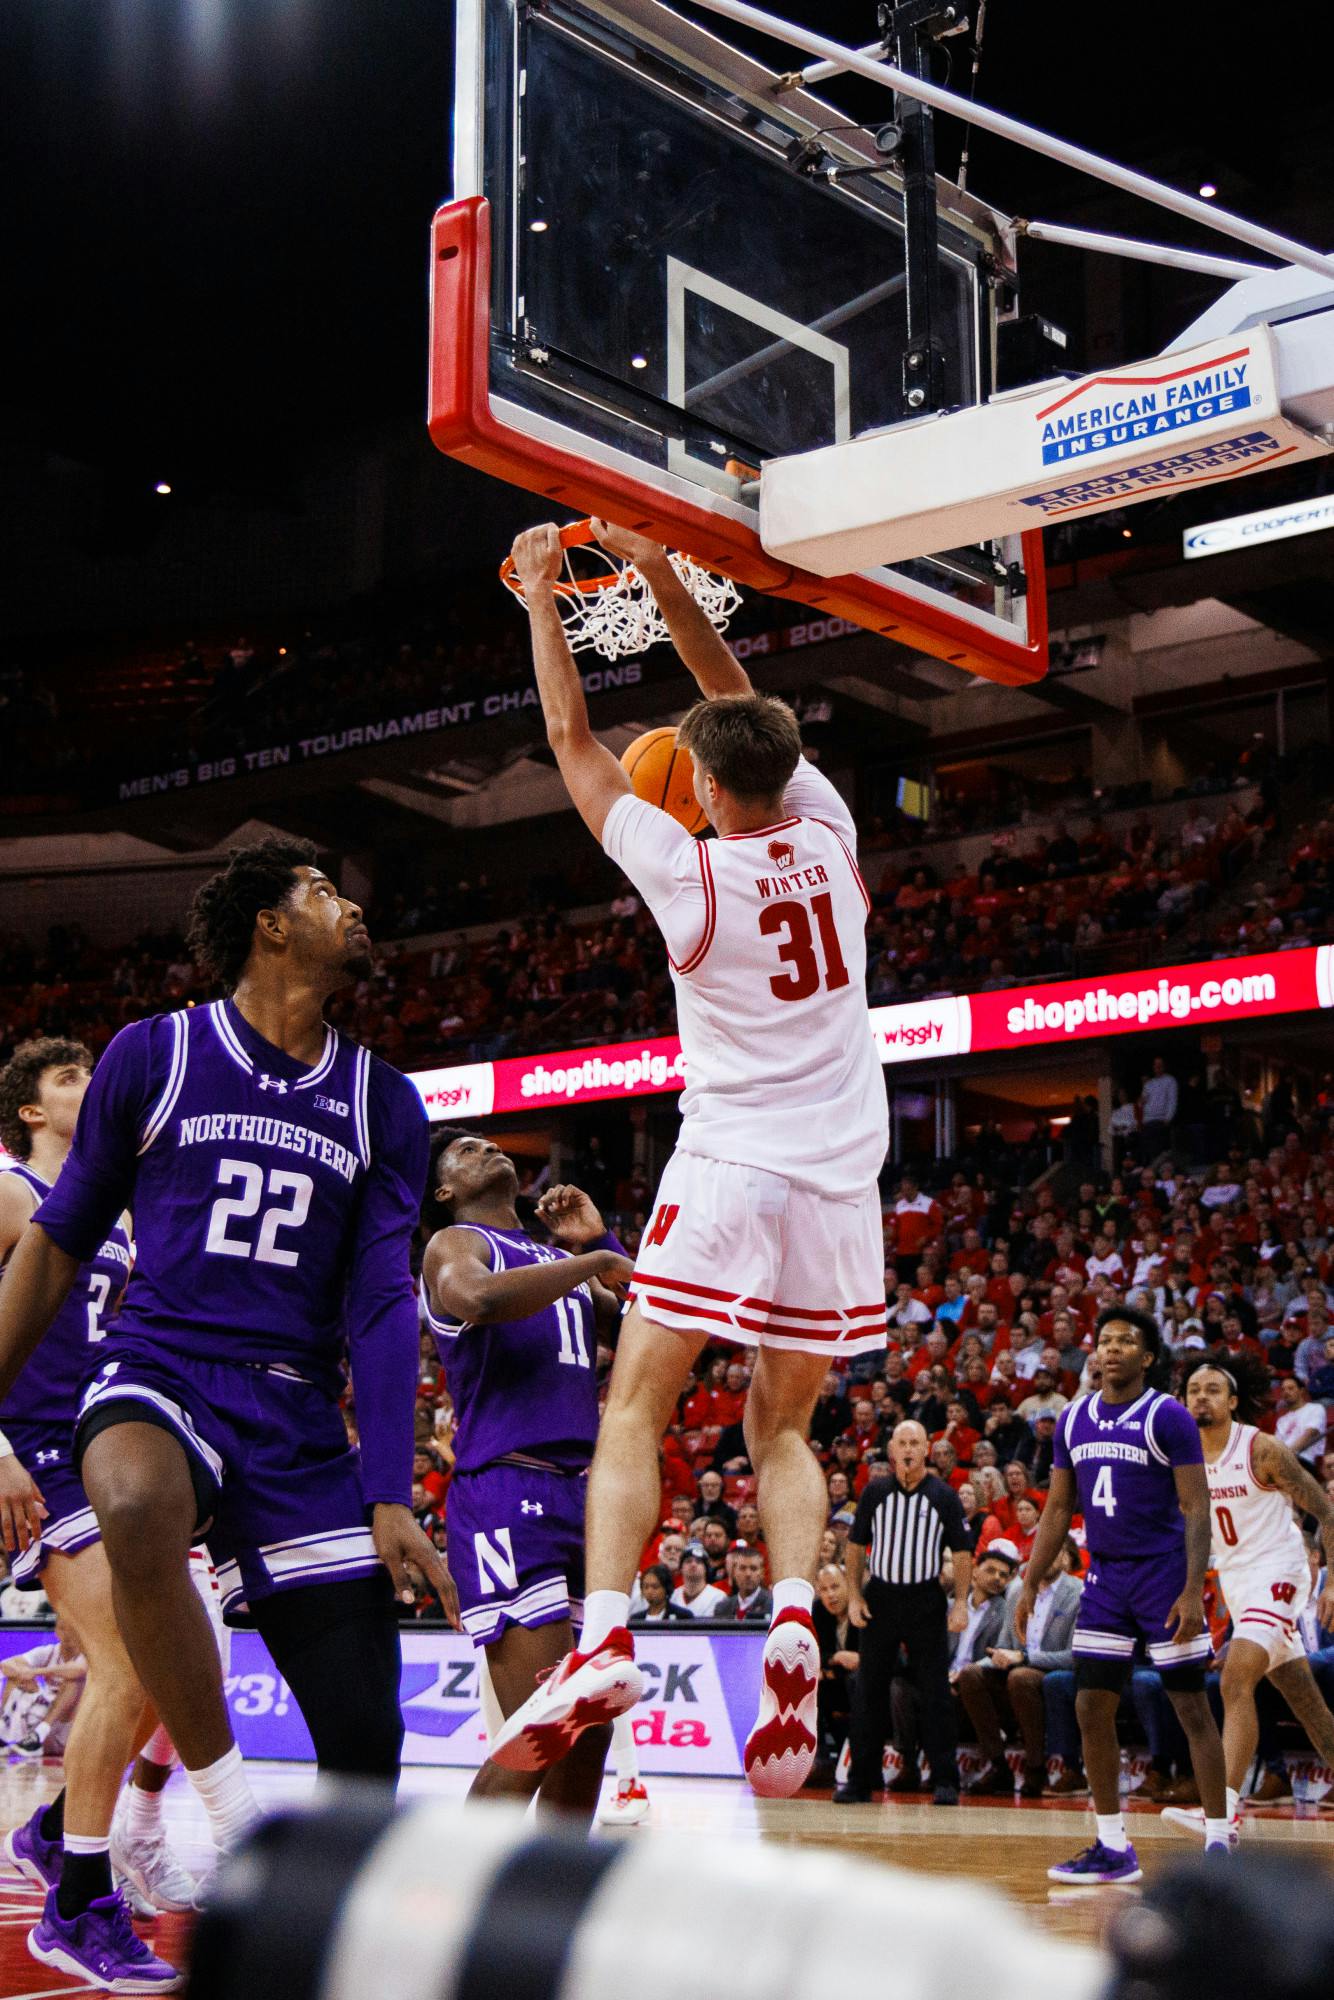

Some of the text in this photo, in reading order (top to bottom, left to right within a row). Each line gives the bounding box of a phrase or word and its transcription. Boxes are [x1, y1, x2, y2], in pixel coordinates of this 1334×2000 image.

[1042, 364, 1247, 442] AMERICAN FAMILY
[1057, 395, 1234, 457] INSURANCE
[1039, 438, 1246, 501] INSURANCE
[1041, 439, 1280, 511] AMERICAN FAMILY
[727, 632, 769, 659] 04
[119, 768, 189, 799] MEN'S
[197, 757, 236, 781] BIG
[244, 745, 290, 770] TEN
[299, 701, 475, 757] TOURNAMENT
[755, 864, 829, 899] WINTER
[759, 892, 850, 1002] 31
[884, 1020, 943, 1046] wiggly
[1007, 972, 1276, 1033] shopthepig.com
[424, 1085, 471, 1106] wiggly
[521, 1050, 688, 1098] shopthepig.c
[178, 1113, 360, 1185] NORTHWESTERN
[205, 1158, 314, 1267] 22
[87, 1273, 111, 1342] 2
[553, 1297, 590, 1369] 11
[1091, 1465, 1117, 1517] 4
[1209, 1484, 1248, 1499] CONSIN
[1214, 1505, 1238, 1547] 0
[473, 1527, 519, 1595] N
[1270, 1581, 1297, 1605] W
